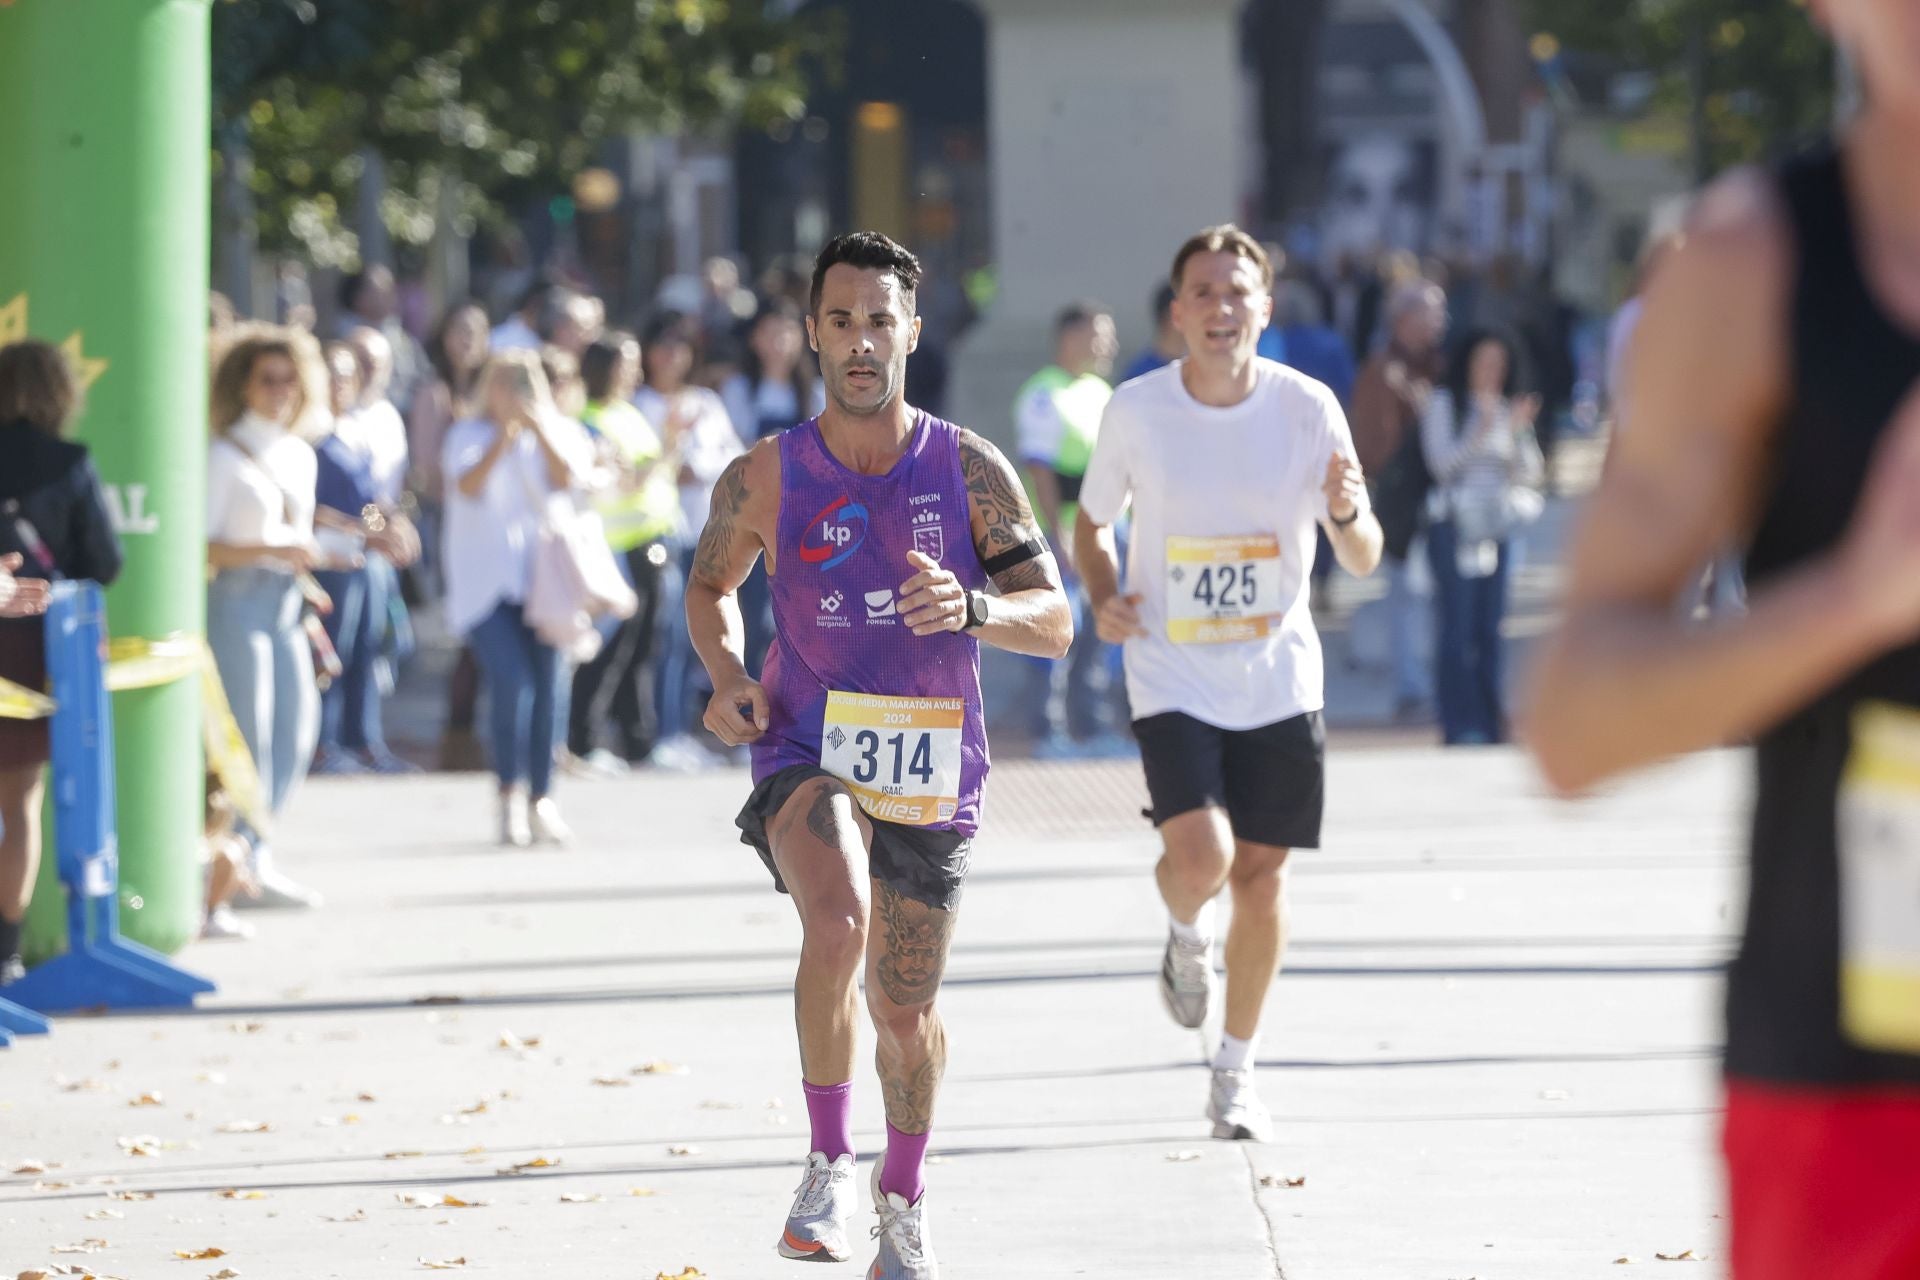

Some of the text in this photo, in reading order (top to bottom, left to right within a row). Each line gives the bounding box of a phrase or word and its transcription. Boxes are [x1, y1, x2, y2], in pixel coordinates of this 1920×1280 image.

[908, 491, 941, 506] VESKIN
[823, 521, 851, 546] kp
[1193, 563, 1256, 607] 425
[866, 618, 896, 626] FONSECA
[858, 697, 888, 709] MEDIA
[889, 698, 933, 710] MARATÓN
[933, 699, 961, 710] AVILÉS
[883, 713, 912, 724] 2024
[853, 729, 934, 785] 314
[881, 785, 903, 796] ISAAC
